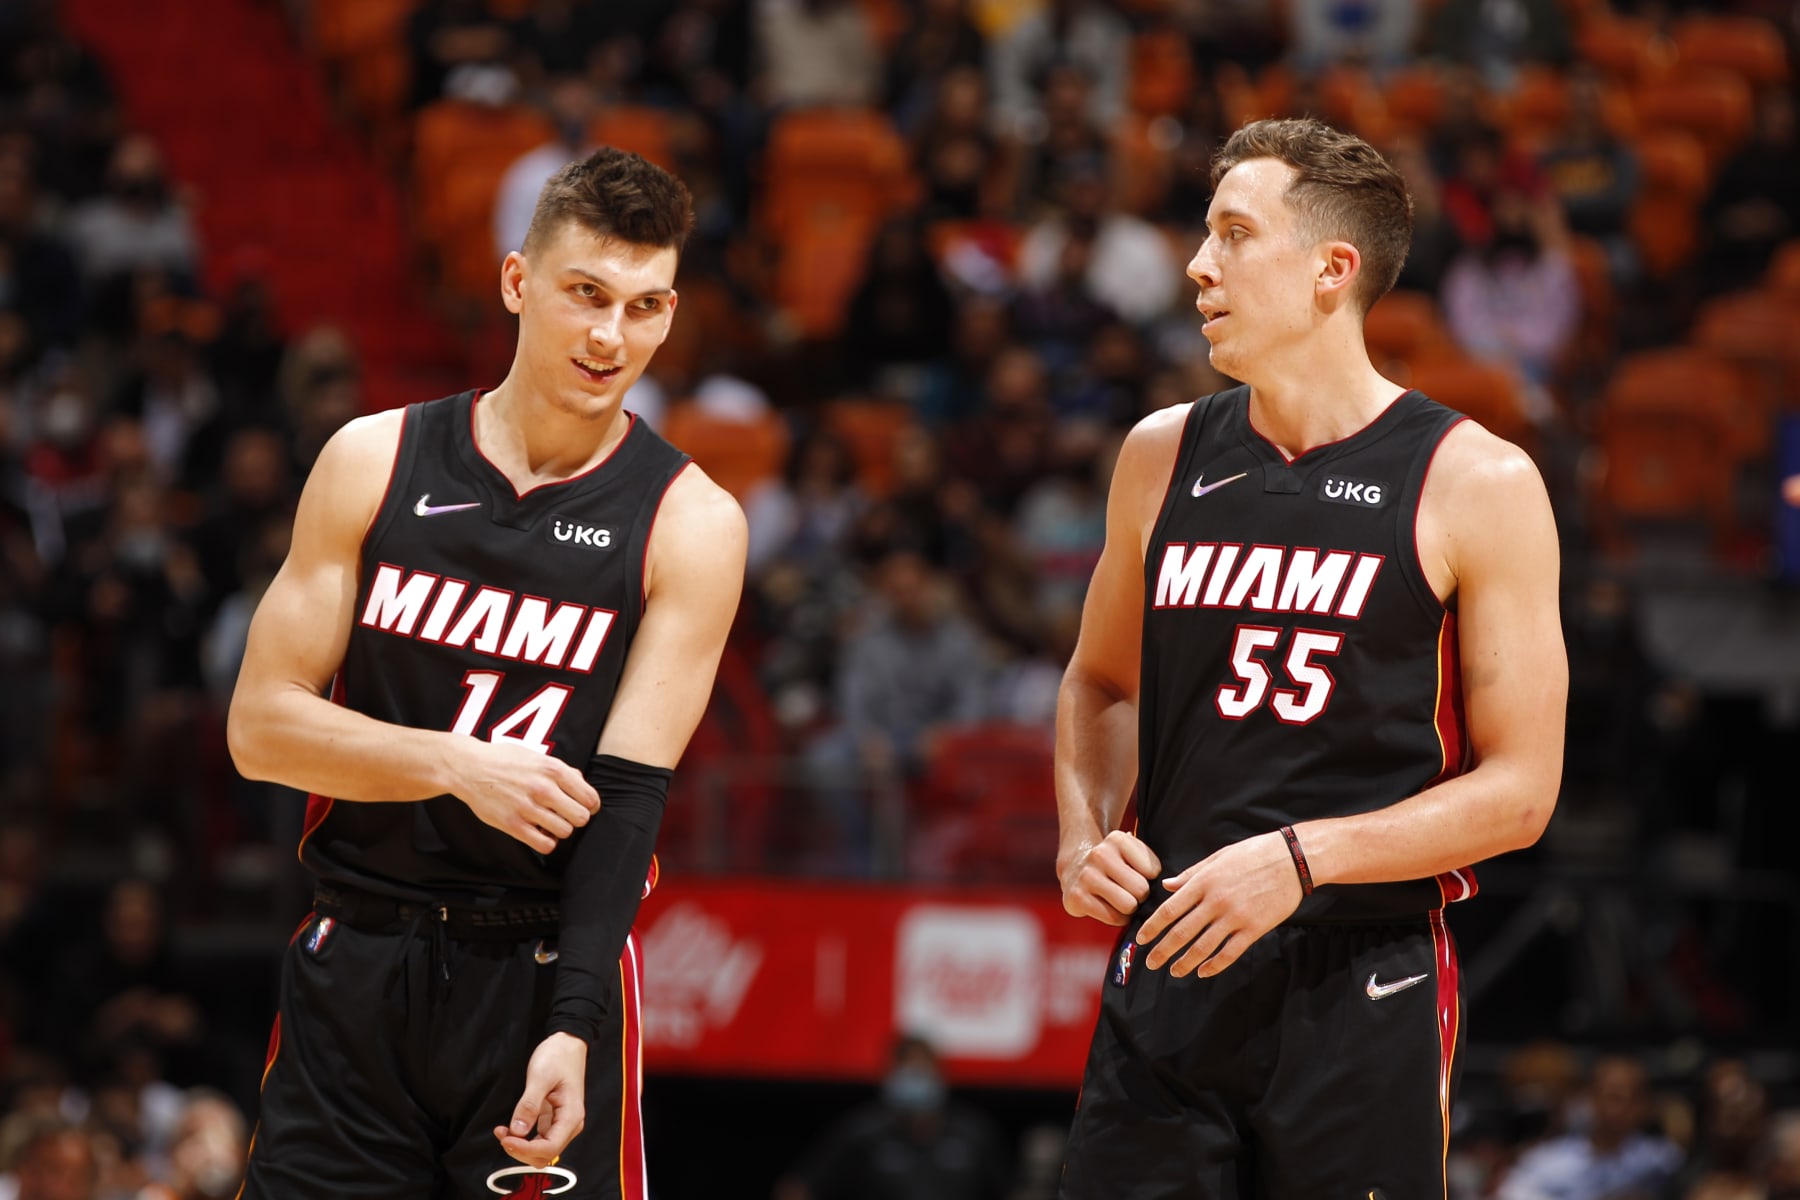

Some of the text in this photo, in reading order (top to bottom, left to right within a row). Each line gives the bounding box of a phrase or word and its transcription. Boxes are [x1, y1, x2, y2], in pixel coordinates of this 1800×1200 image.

[359, 562, 618, 674] MIAMI
[1152, 542, 1386, 620] MIAMI
[450, 669, 574, 756] 14
[1214, 624, 1345, 726] 55
